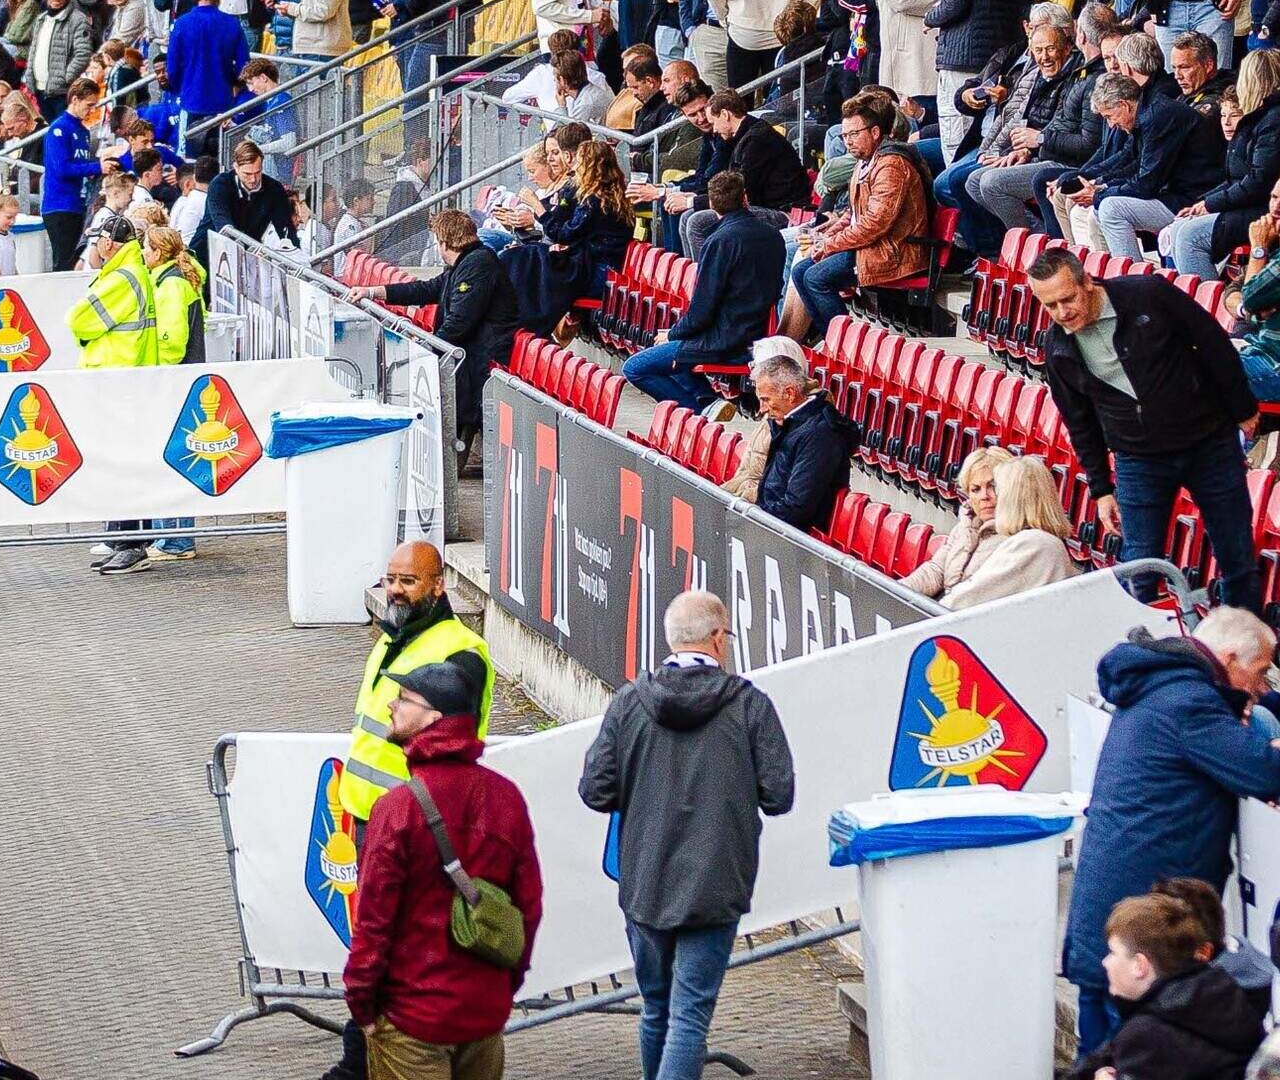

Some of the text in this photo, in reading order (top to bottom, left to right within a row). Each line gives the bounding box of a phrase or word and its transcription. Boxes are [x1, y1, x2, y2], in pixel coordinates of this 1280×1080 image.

[188, 437, 237, 452] TELSTAR
[7, 446, 57, 461] TELSTAR
[922, 729, 1002, 762] TELSTAR
